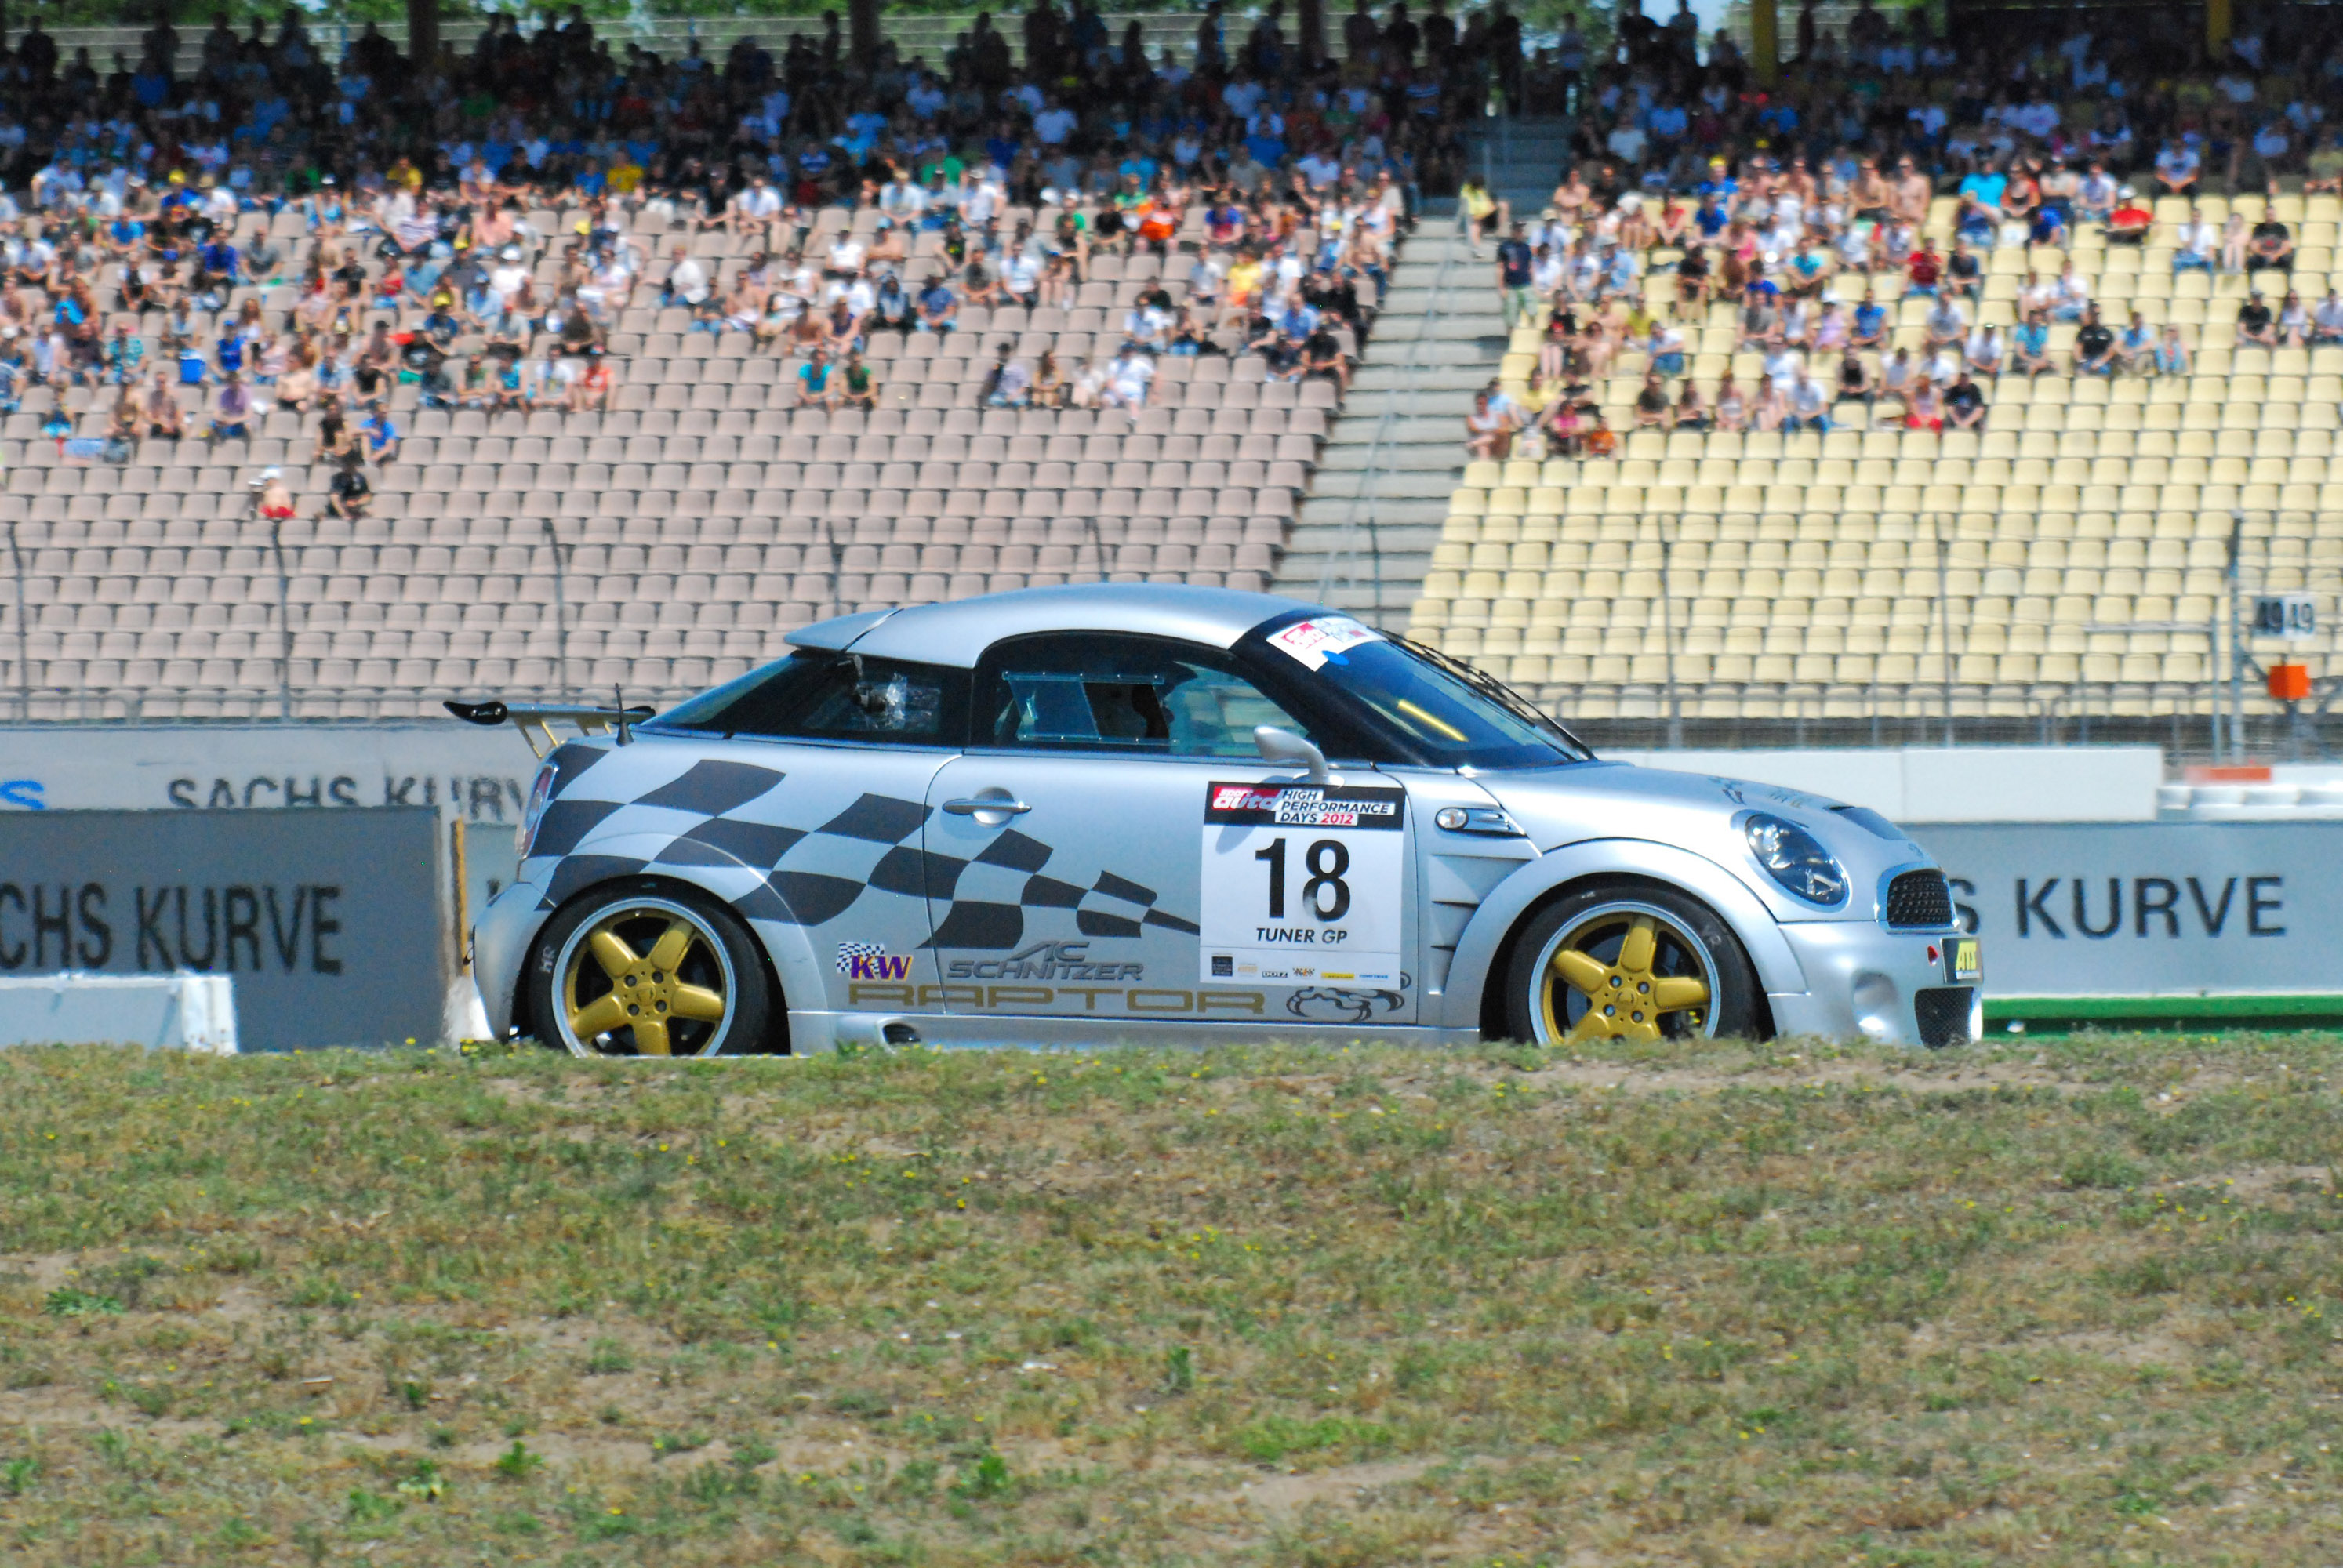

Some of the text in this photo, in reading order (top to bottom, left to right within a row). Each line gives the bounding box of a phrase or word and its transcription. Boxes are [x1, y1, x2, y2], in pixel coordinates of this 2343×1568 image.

[168, 775, 359, 806] SACHS
[1219, 789, 1253, 798] sport
[1281, 790, 1317, 800] HIGH
[1213, 793, 1280, 811] auto
[1280, 801, 1389, 814] PERFORMANCE
[1280, 813, 1353, 825] DAYS 2012
[1255, 838, 1351, 923] 18
[2016, 876, 2287, 940] KURVE
[135, 884, 343, 975] KURVE
[1256, 927, 1348, 944] TUNER GP
[1008, 941, 1090, 962] AC
[850, 955, 913, 981] KW
[946, 960, 1144, 981] SCHNITZER
[848, 983, 1265, 1014] RAPTOR
